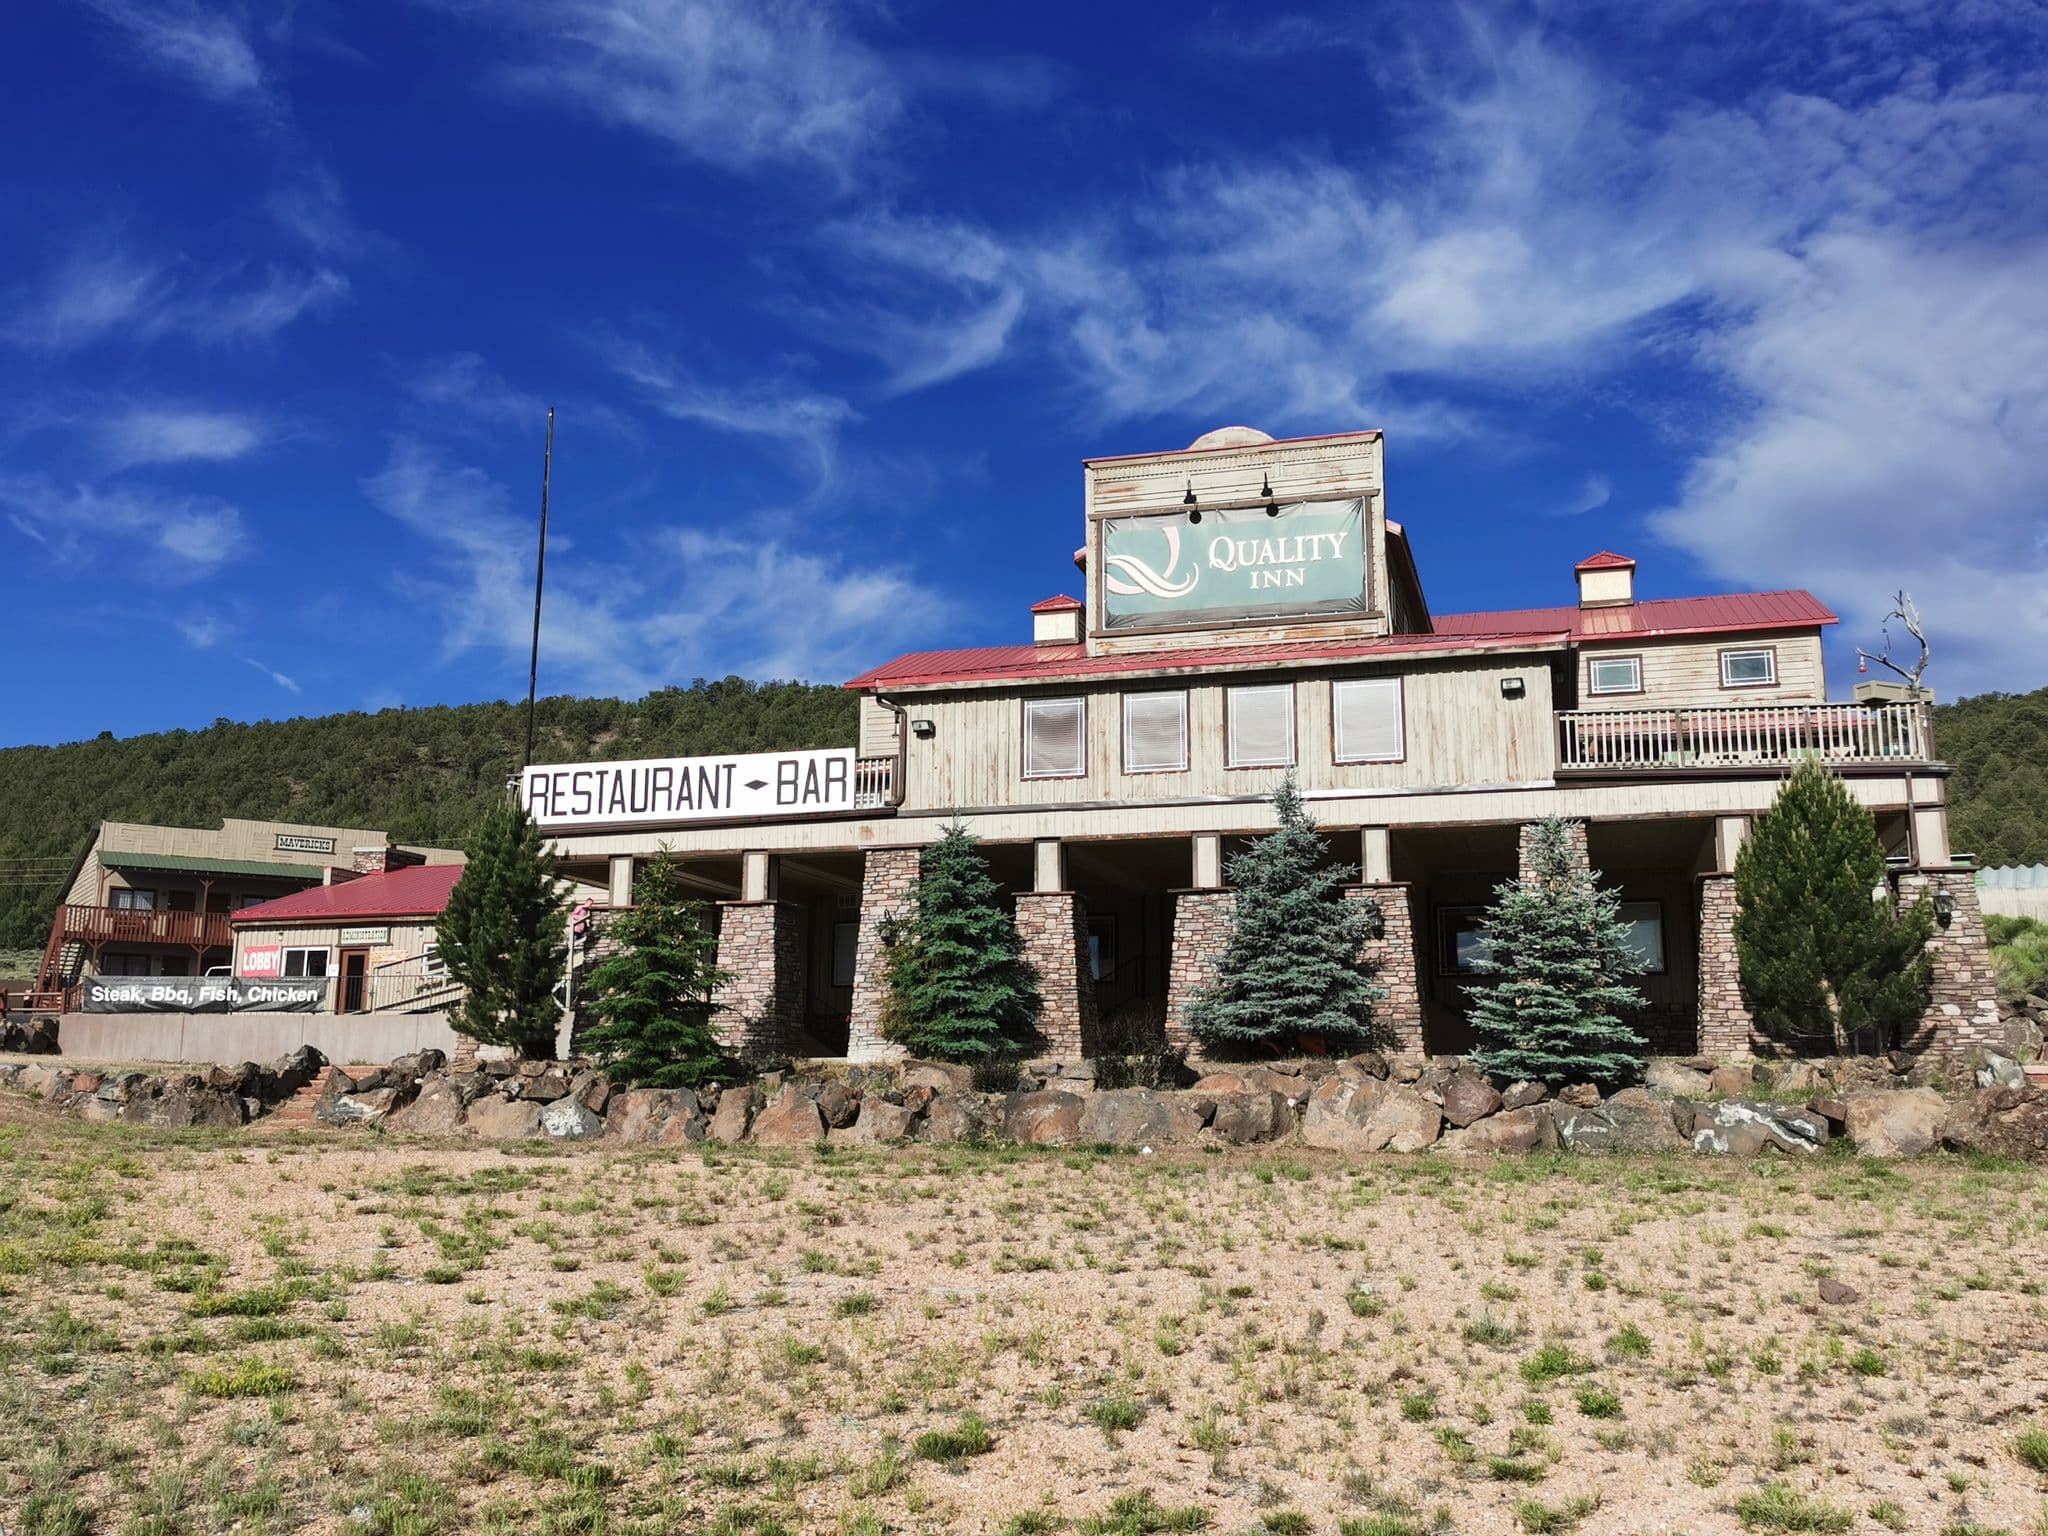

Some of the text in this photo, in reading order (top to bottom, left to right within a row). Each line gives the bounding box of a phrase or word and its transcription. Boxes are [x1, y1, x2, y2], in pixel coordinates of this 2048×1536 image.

[1208, 532, 1348, 572] QUALITY
[1249, 568, 1305, 589] INN
[528, 757, 848, 817] RESTAURANT BAR
[279, 837, 331, 850] MAVERICKS
[243, 951, 278, 971] LOBBY
[91, 986, 319, 1004] Steak, Bbq, Fish, Chicken
